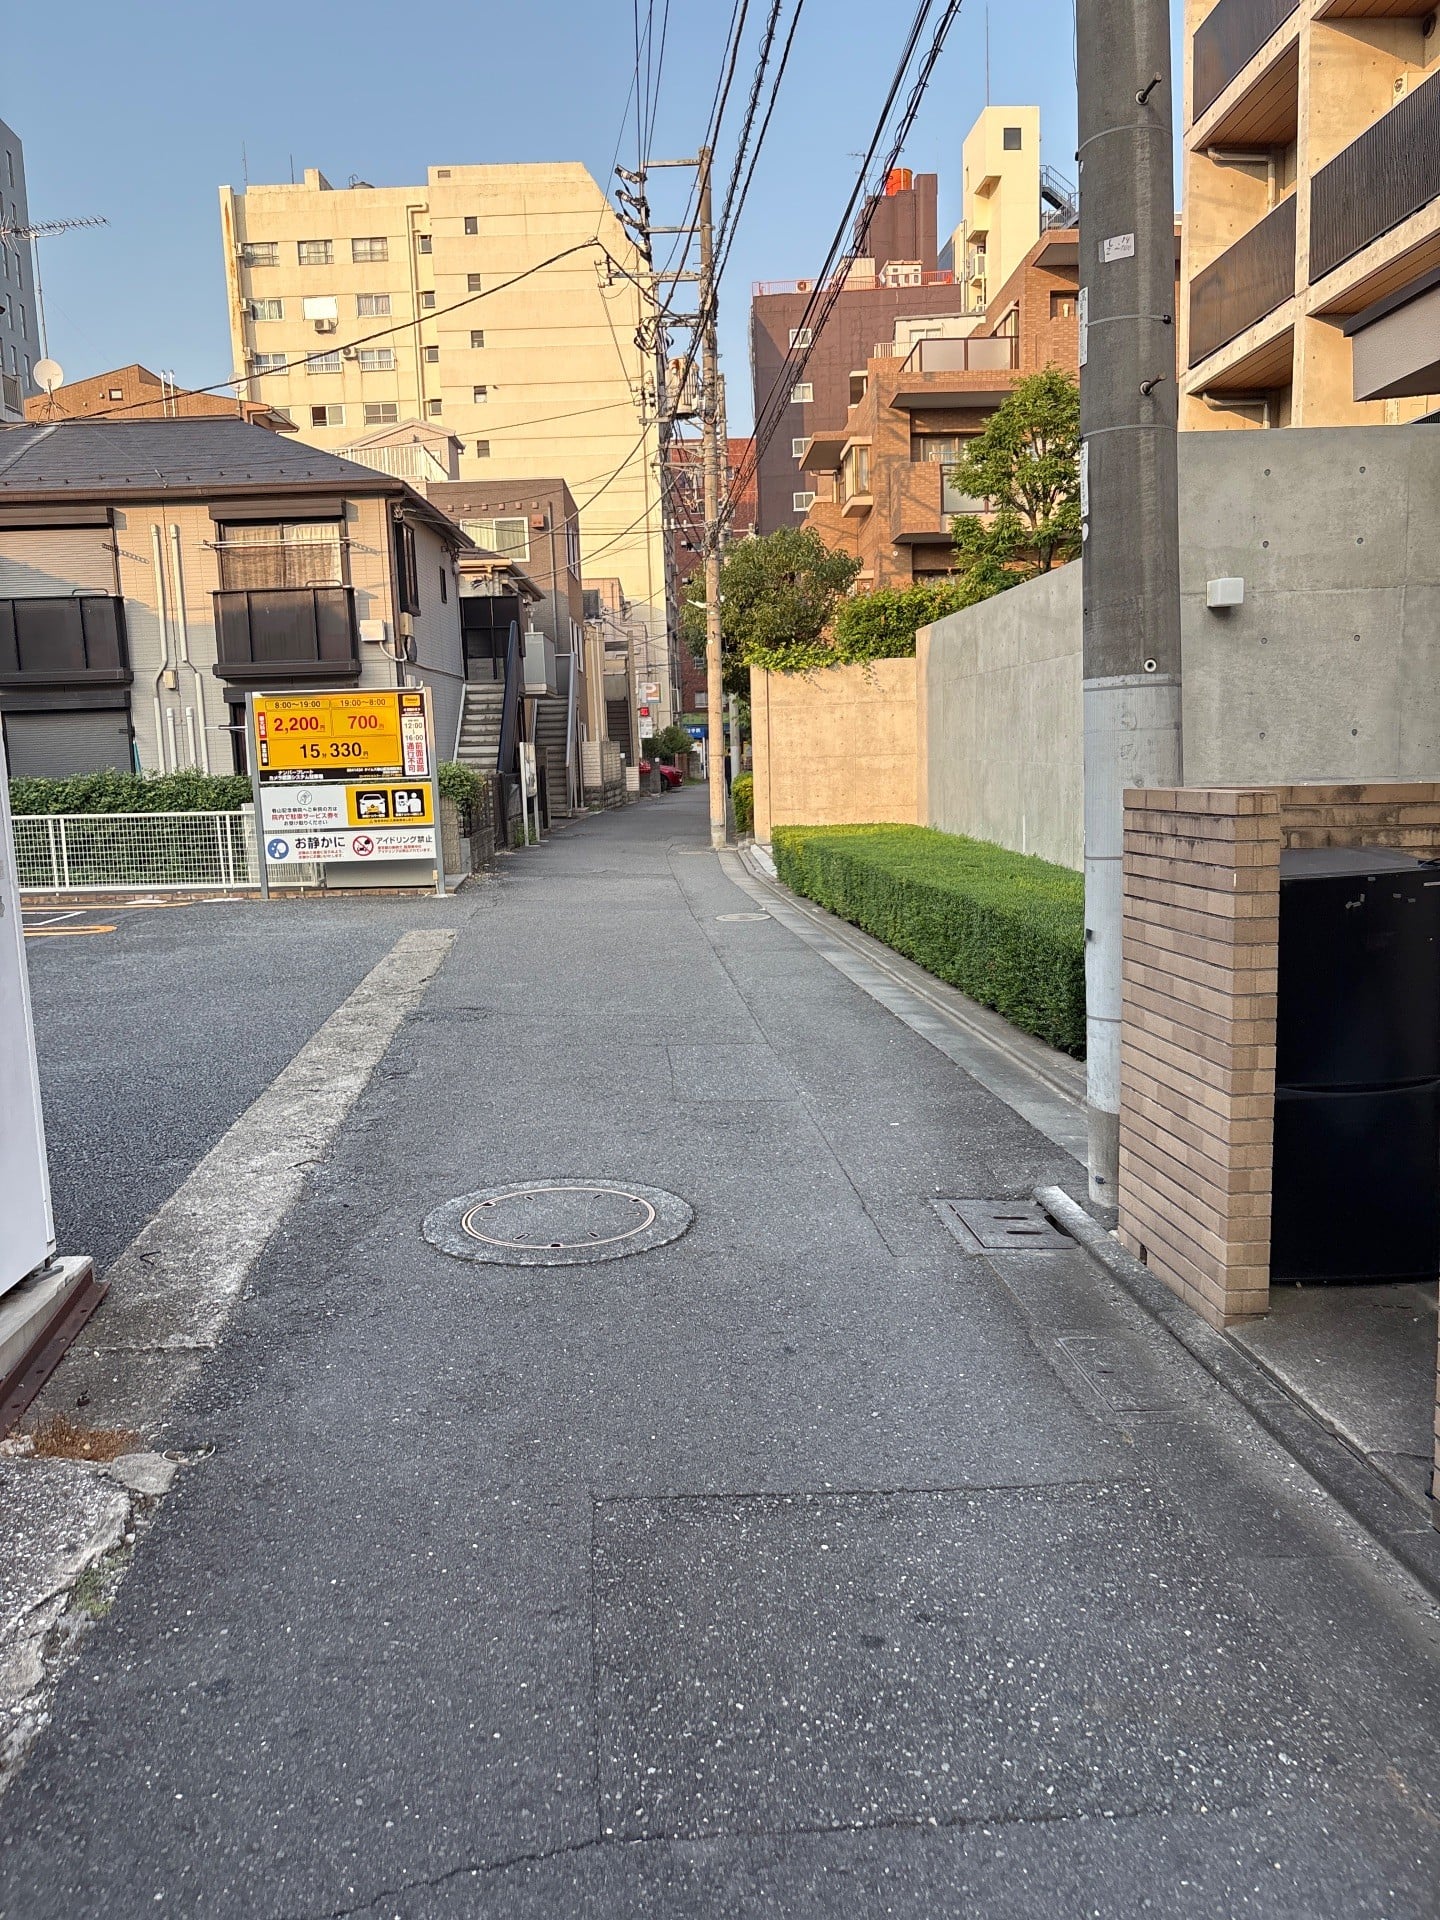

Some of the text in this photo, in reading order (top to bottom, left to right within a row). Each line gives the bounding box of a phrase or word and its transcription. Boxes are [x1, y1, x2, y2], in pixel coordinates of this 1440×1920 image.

[406, 742, 416, 773] 通行不可
[415, 742, 425, 772] 前面道路
[294, 836, 346, 849] お静かに
[375, 834, 433, 845] アイドリング禁止
